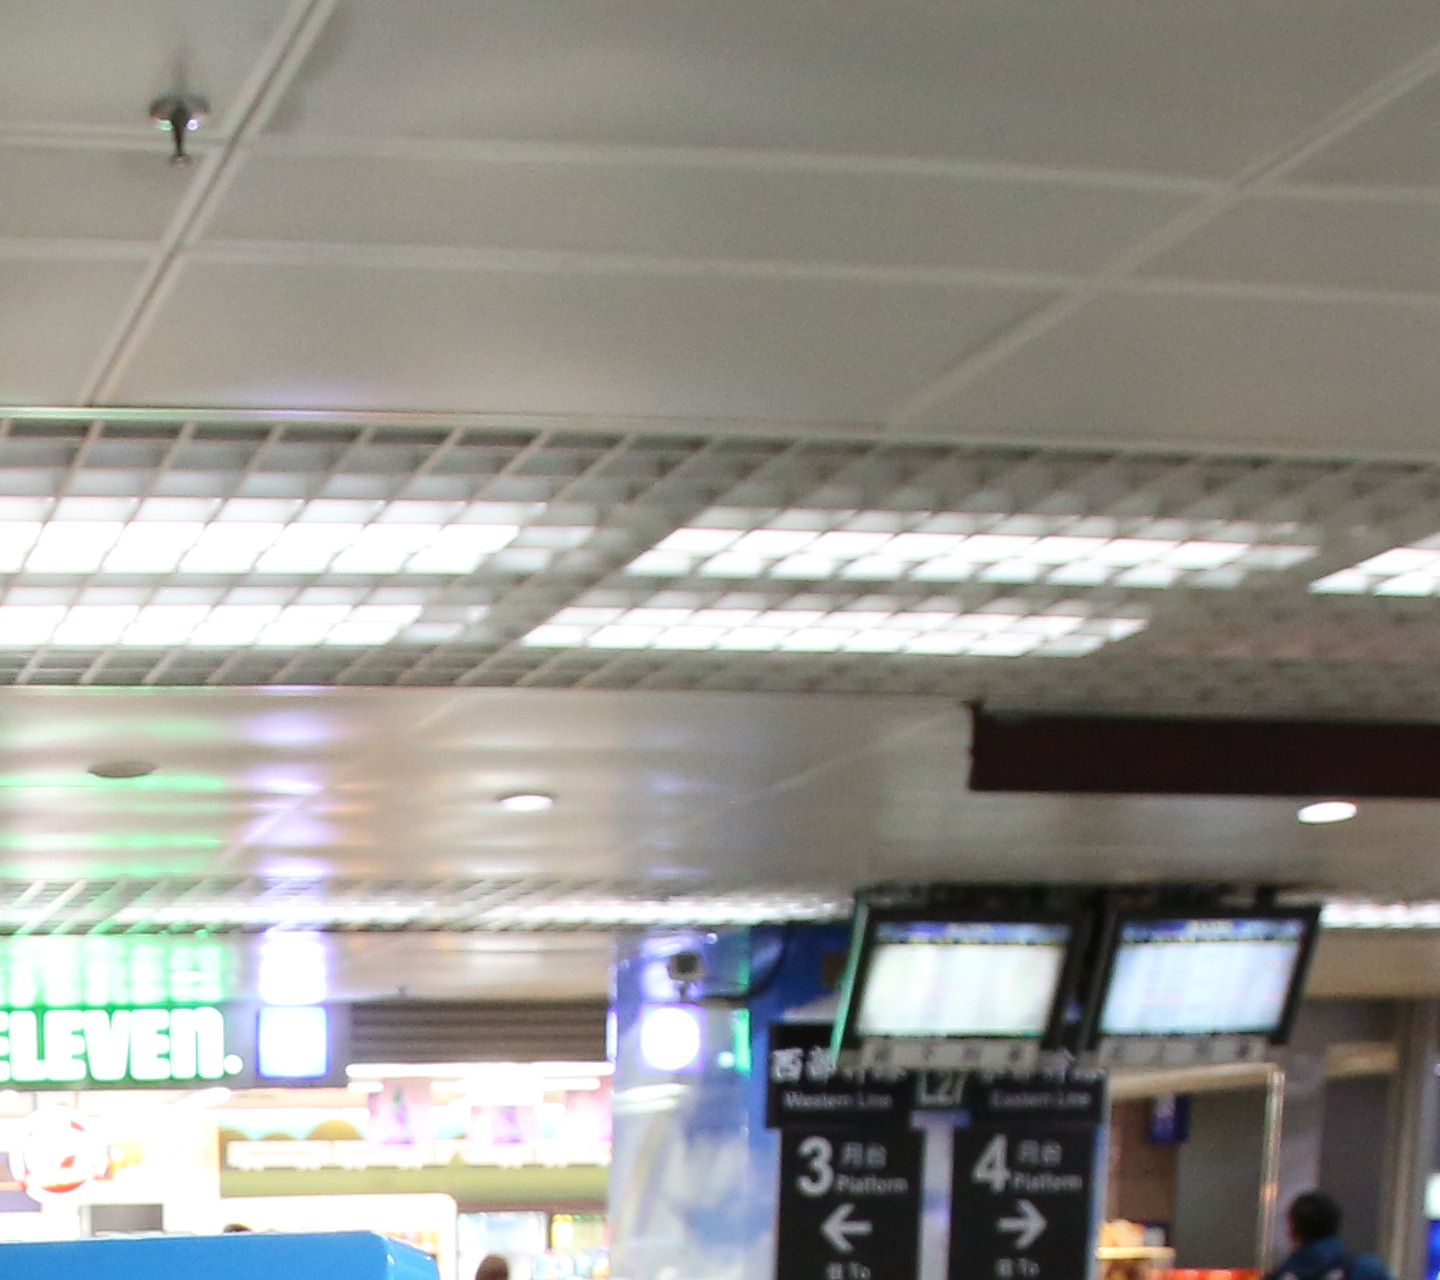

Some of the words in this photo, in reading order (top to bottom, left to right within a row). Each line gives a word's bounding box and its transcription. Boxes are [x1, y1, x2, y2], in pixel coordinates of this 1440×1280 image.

[795, 1135, 834, 1198] 3
[972, 1133, 1012, 1193] 4
[1012, 1171, 1083, 1194] Platform
[834, 1173, 909, 1195] Platform
